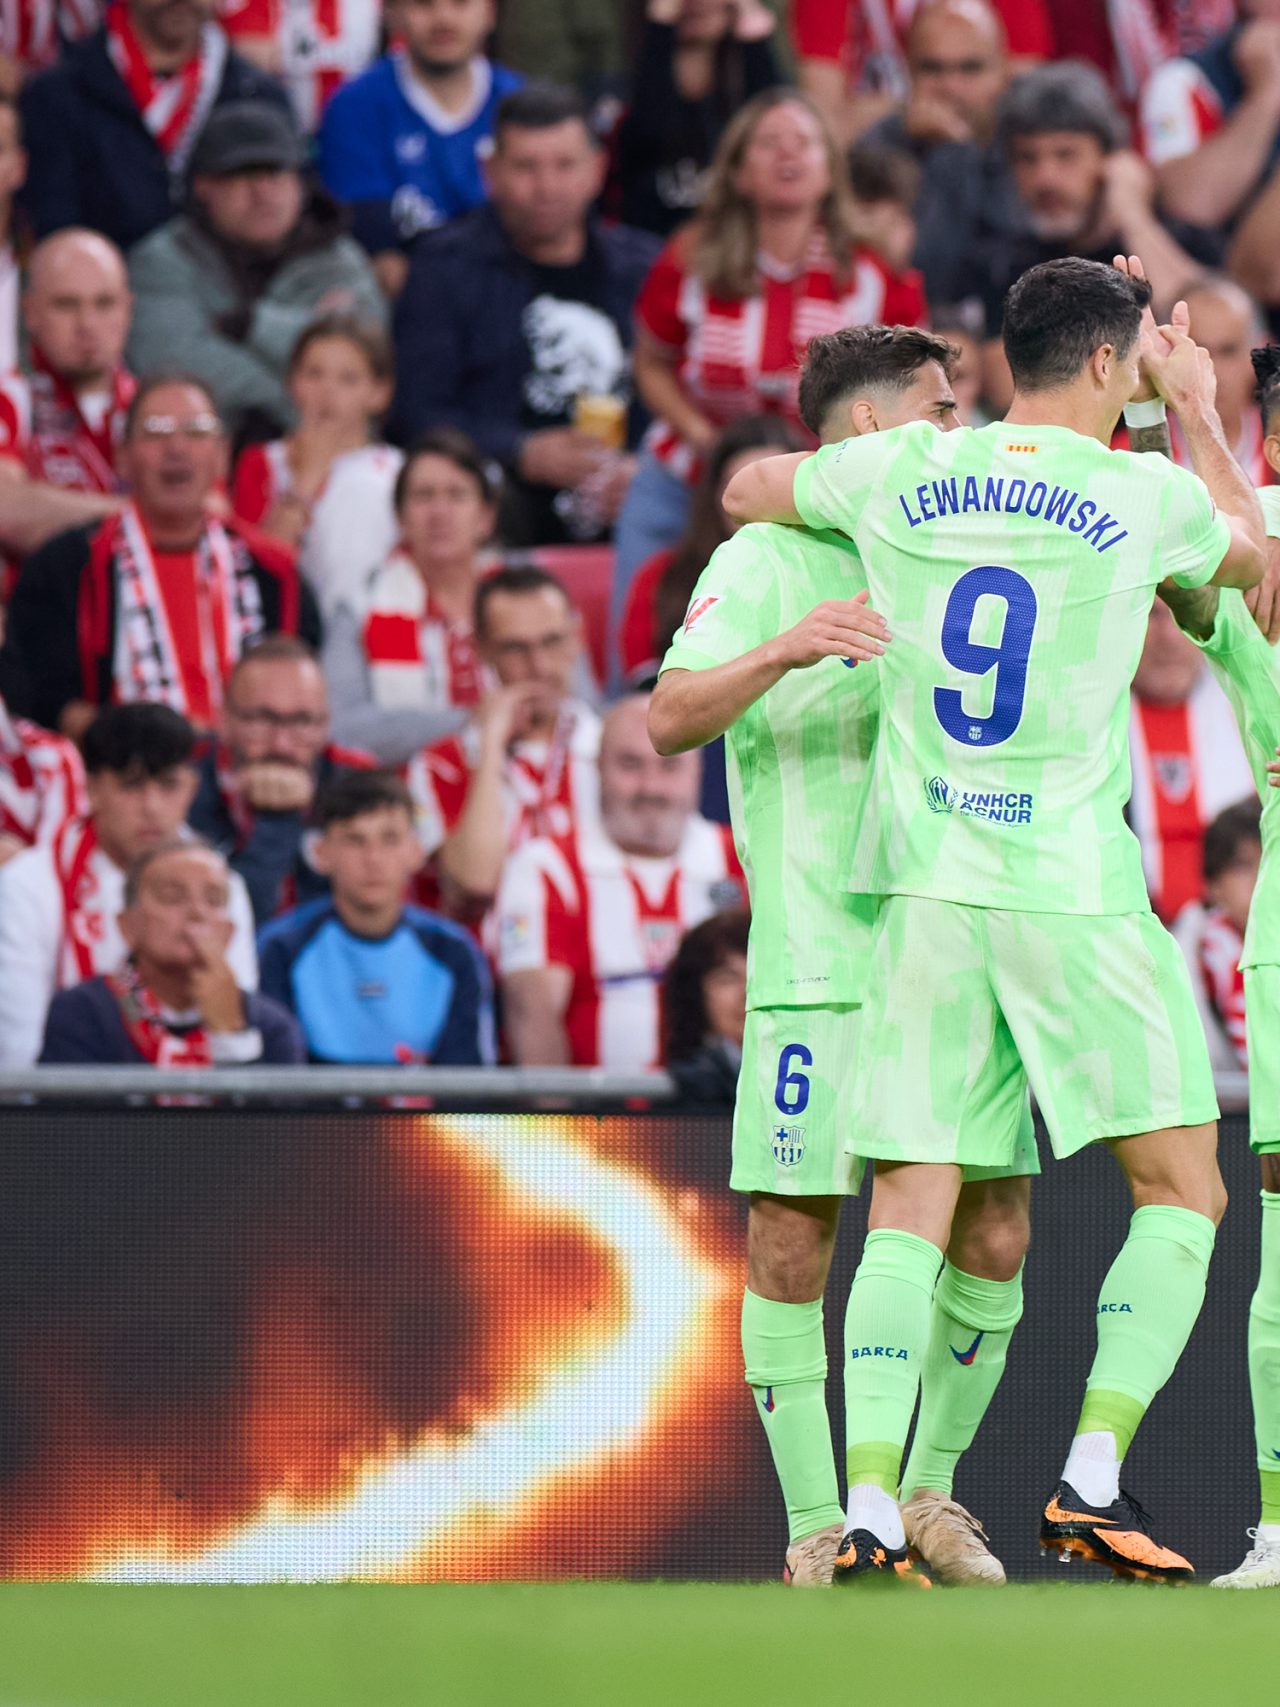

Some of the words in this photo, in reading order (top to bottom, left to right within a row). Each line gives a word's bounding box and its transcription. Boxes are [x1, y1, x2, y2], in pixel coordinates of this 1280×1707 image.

[899, 476, 1128, 553] LEWANDOWSKI
[934, 566, 1037, 746] 9
[960, 802, 1032, 823] ACNUR
[963, 792, 1032, 808] UNHCR
[775, 1043, 812, 1115] 6
[851, 1346, 909, 1360] BARÇA
